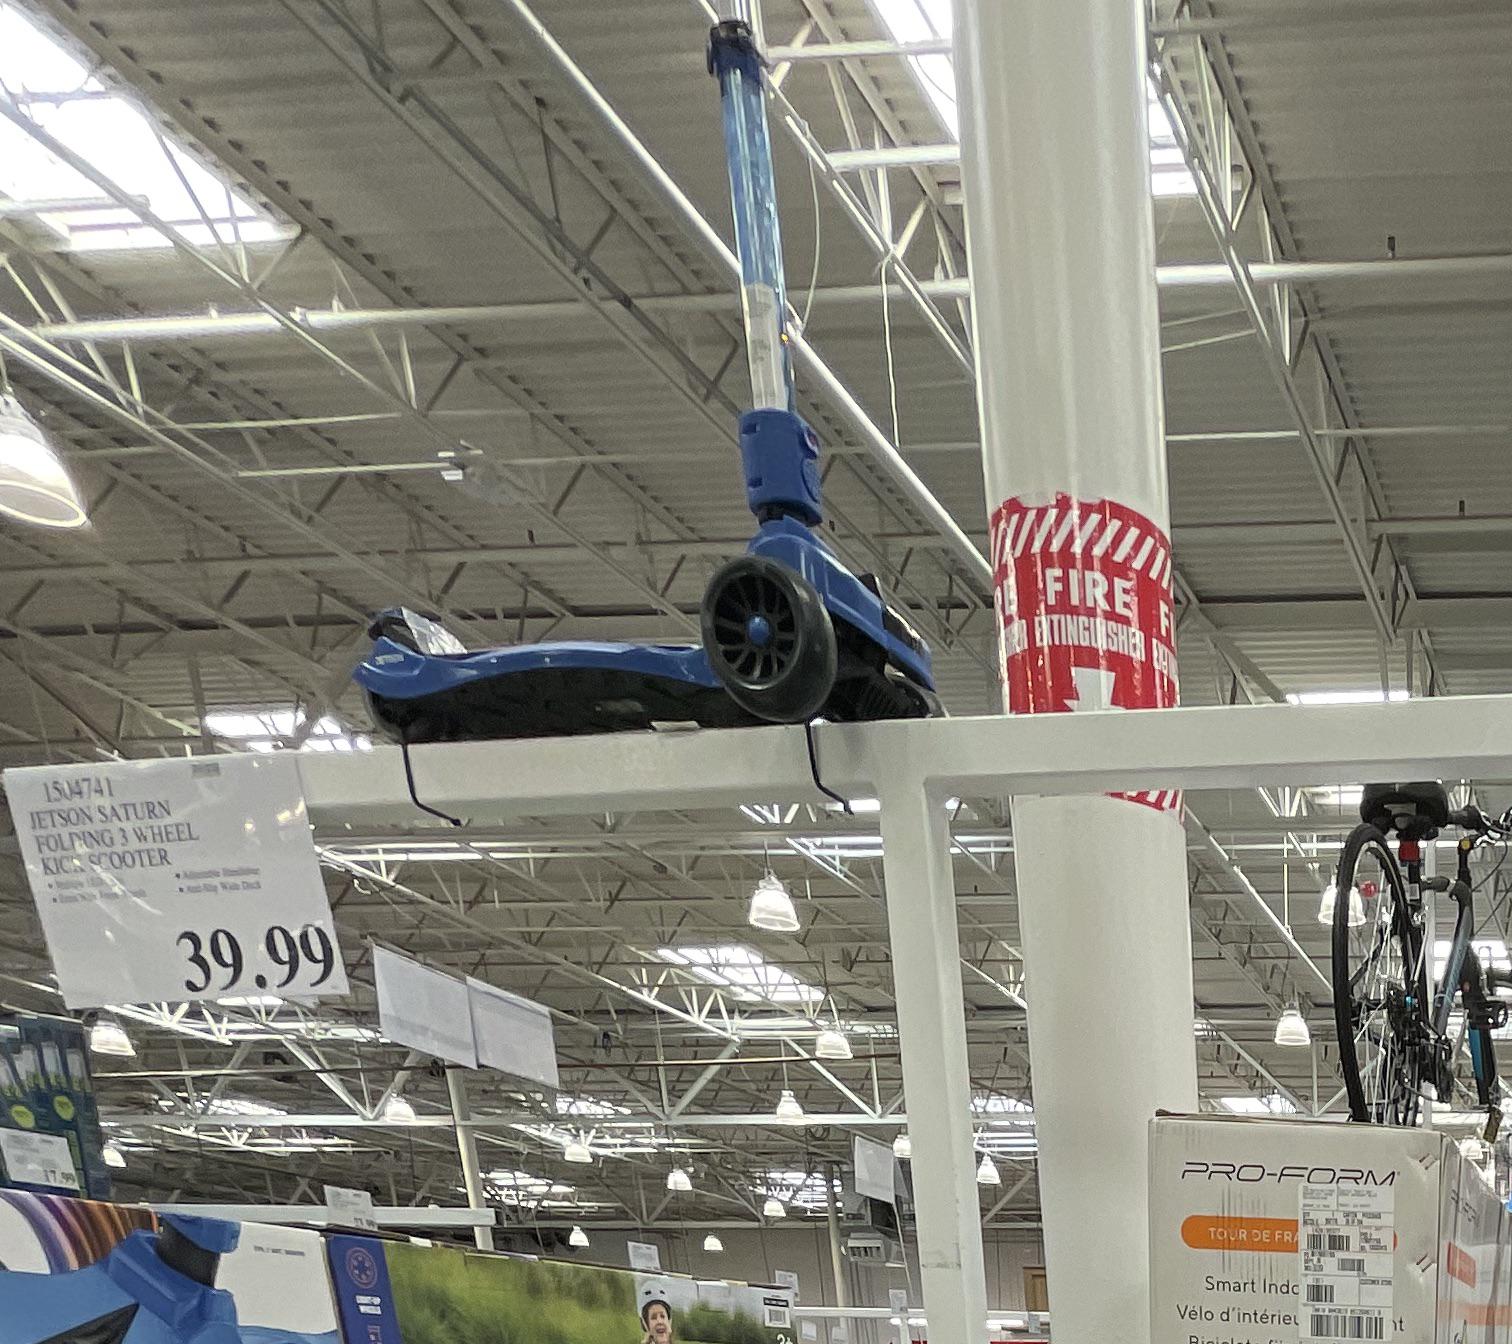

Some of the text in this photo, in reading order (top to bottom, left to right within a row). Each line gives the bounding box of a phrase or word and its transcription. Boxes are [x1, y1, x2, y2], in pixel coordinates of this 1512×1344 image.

[1045, 567, 1136, 618] FIRE
[99, 800, 172, 823] SATURN
[119, 827, 129, 847] 3
[132, 822, 199, 844] WHEEL
[176, 924, 335, 992] 39.99
[1181, 1161, 1399, 1187] PRO-FORM
[1208, 1227, 1271, 1243] TOUR DE
[1205, 1276, 1256, 1294] Smart
[1176, 1304, 1215, 1321] Vélo
